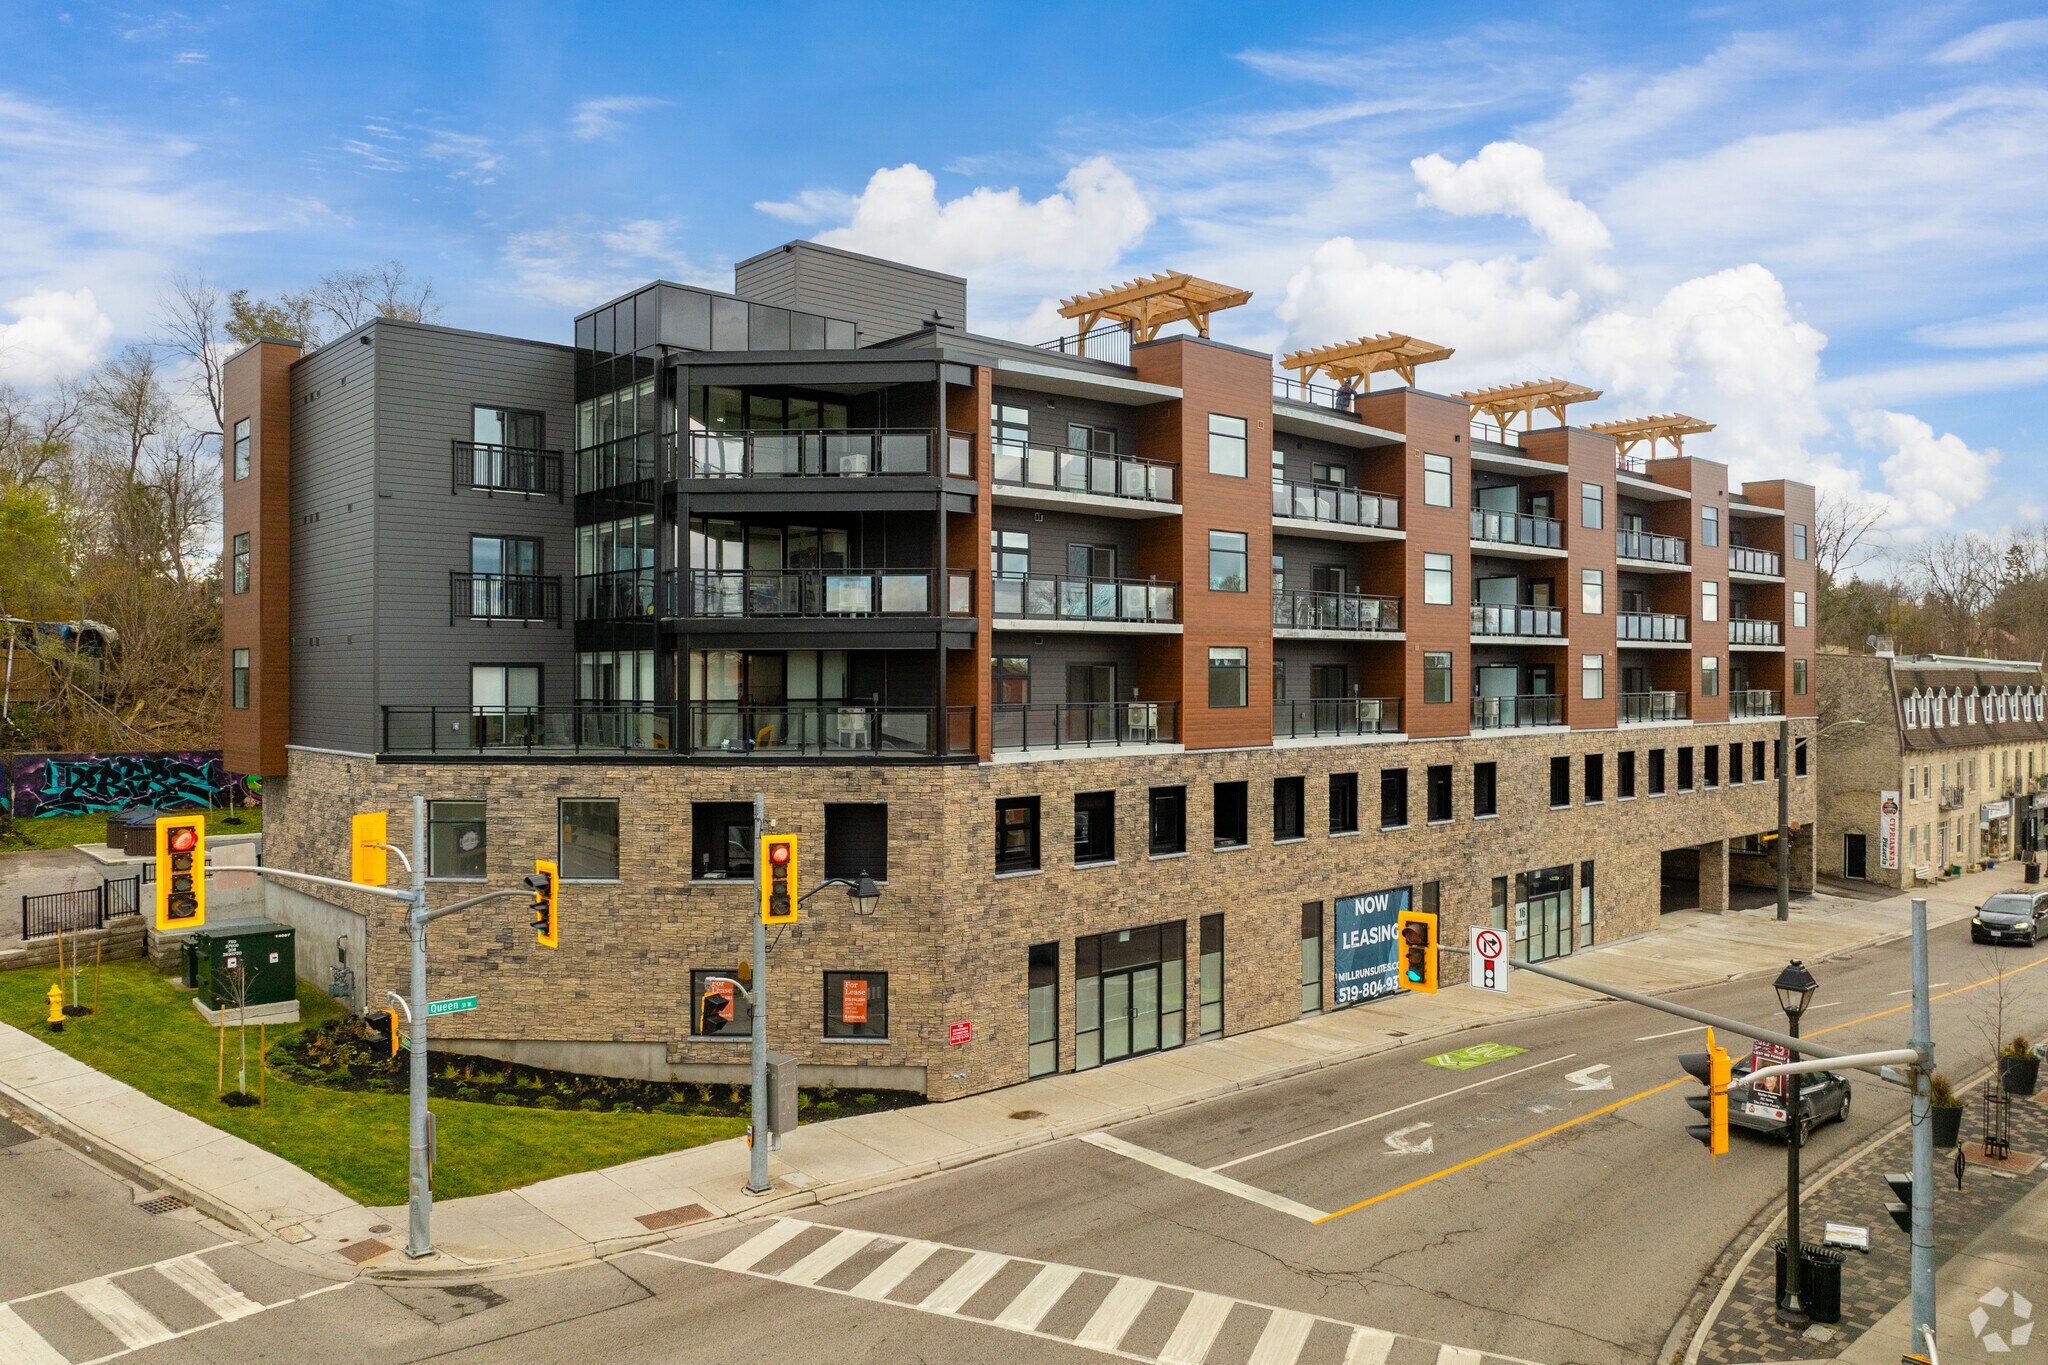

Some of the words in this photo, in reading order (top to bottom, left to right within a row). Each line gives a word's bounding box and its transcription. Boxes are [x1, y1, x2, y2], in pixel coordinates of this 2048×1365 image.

[1355, 894, 1389, 916] NOW
[1342, 923, 1399, 950] LEASING
[1338, 961, 1399, 982] MILLRUNSUITES.CO
[845, 988, 866, 996] Lease
[1339, 975, 1400, 1003] 519-804-93
[430, 1002, 459, 1013] Queen
